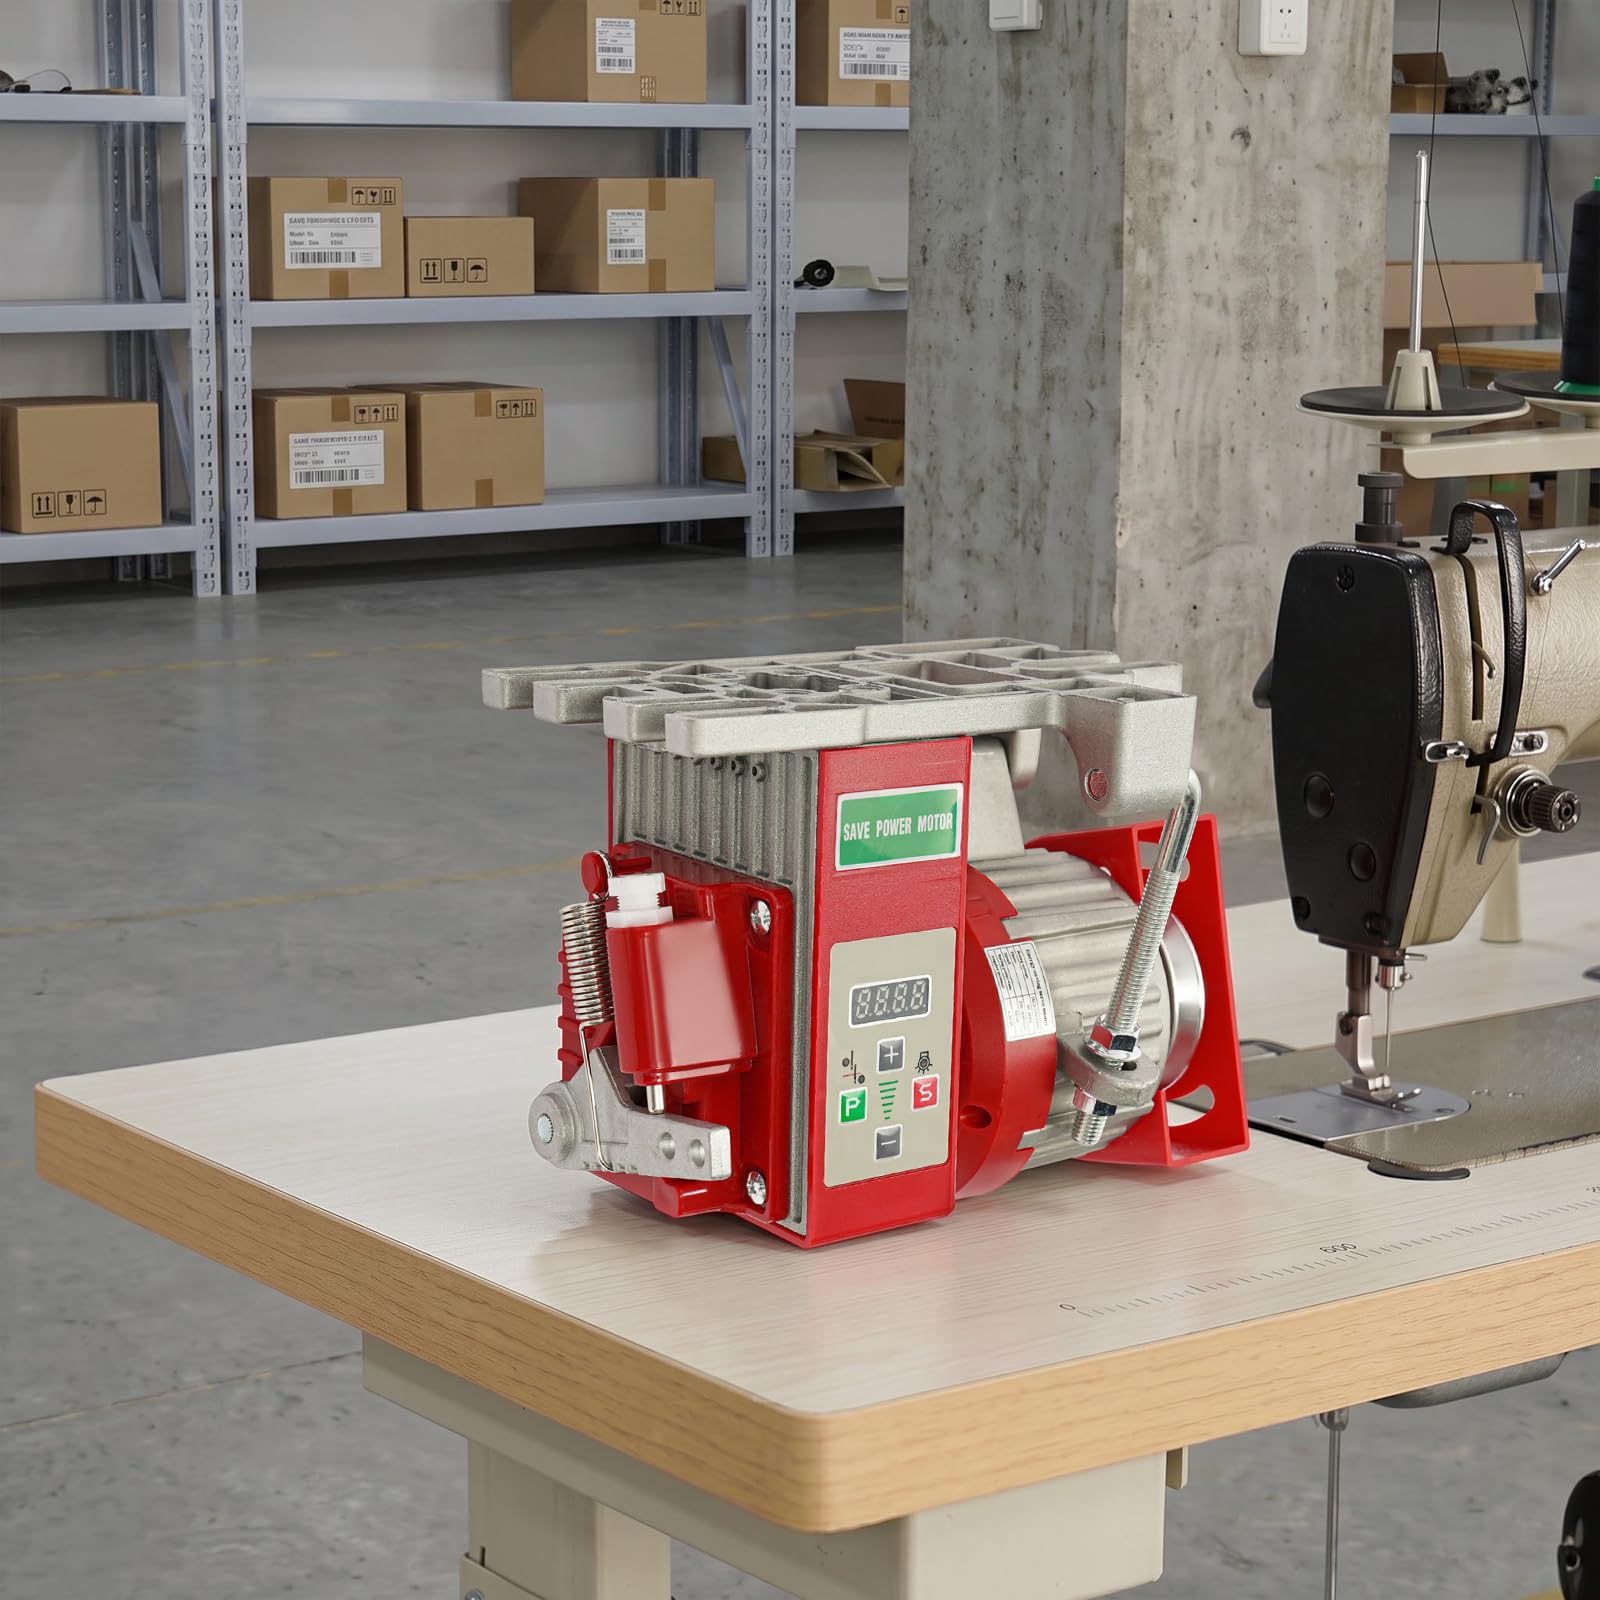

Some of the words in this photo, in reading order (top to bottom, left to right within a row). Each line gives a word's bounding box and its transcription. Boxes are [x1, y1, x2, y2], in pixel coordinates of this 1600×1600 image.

[843, 820, 870, 842] SAVE
[876, 817, 912, 839] POWER
[917, 812, 953, 833] MOTOR
[919, 1082, 933, 1102] S
[845, 1097, 861, 1117] P
[1319, 1243, 1357, 1253] 600
